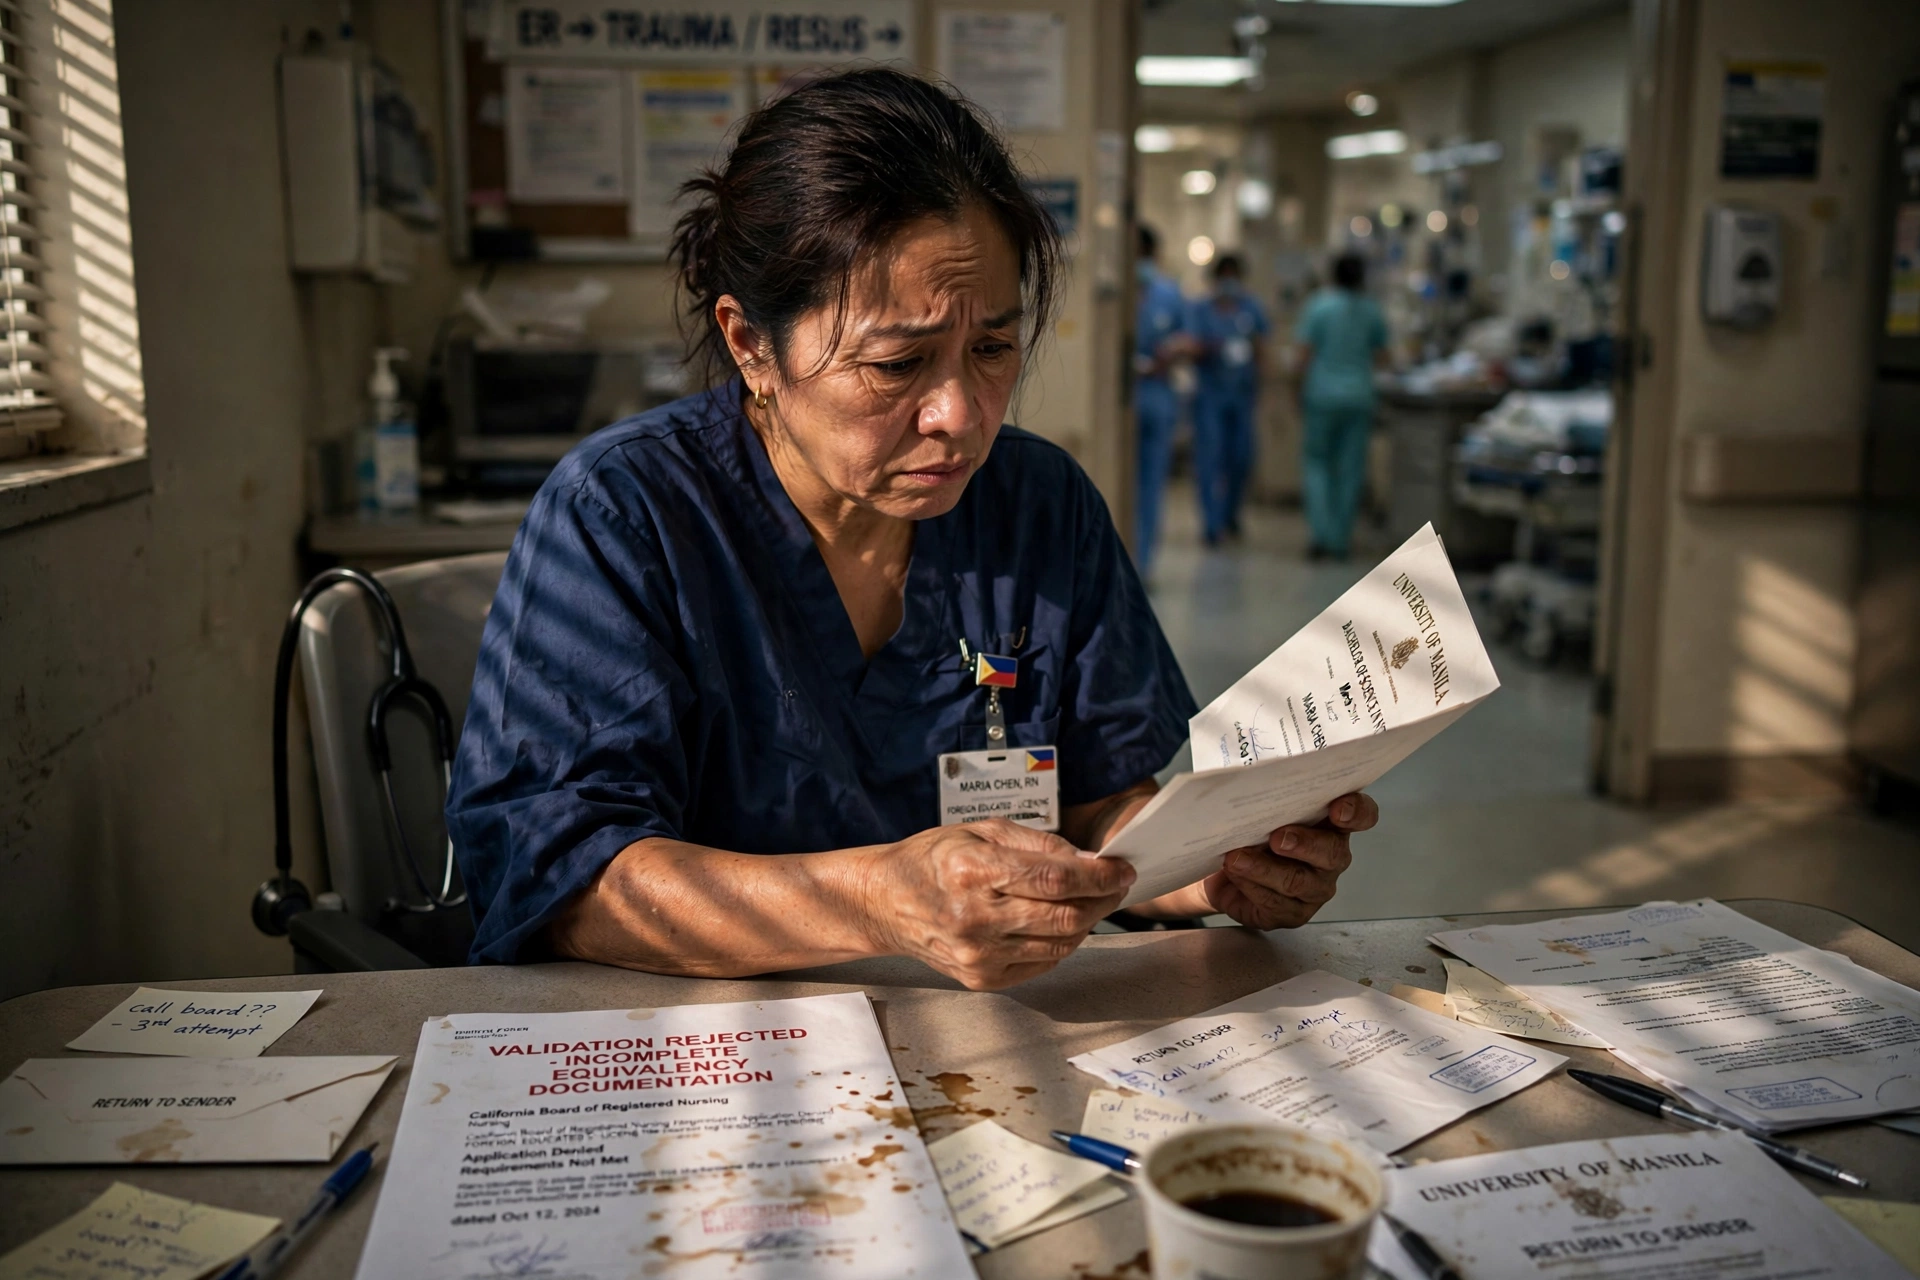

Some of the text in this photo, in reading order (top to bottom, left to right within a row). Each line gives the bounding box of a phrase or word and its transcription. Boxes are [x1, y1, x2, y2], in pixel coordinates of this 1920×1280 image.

[517, 9, 562, 47] ER
[604, 11, 739, 52] TRAUMA
[765, 15, 867, 53] RESUS
[1341, 619, 1365, 670] BACHELOR
[1393, 572, 1450, 706] UNIVERSITY OF MANILA
[1302, 691, 1319, 726] MARIA
[960, 776, 1039, 792] MARIA CHEN, RN
[130, 1018, 173, 1031] 3rd
[173, 1022, 263, 1040] attempt
[489, 1028, 808, 1057] VALIDATION REJECTED
[1131, 1024, 1237, 1066] RETURN TO SENDER
[564, 1046, 740, 1067] INCOMPLETE
[552, 1058, 750, 1081] EQUIVALENCY
[529, 1070, 774, 1096] DOCUMENTATION
[92, 1096, 237, 1109] RETURN TO SENDER
[469, 1097, 729, 1119] California Board of Registered Nursing
[462, 1144, 605, 1163] Application Denied
[460, 1156, 629, 1176] Requirements Not Met
[1418, 1151, 1723, 1203] UNIVERSITY OF MANILA
[450, 1205, 600, 1226] dated Oct 12, 2024
[1522, 1234, 1621, 1261] RETURN
[1627, 1229, 1661, 1247] TO
[1661, 1217, 1756, 1242] SENDER
